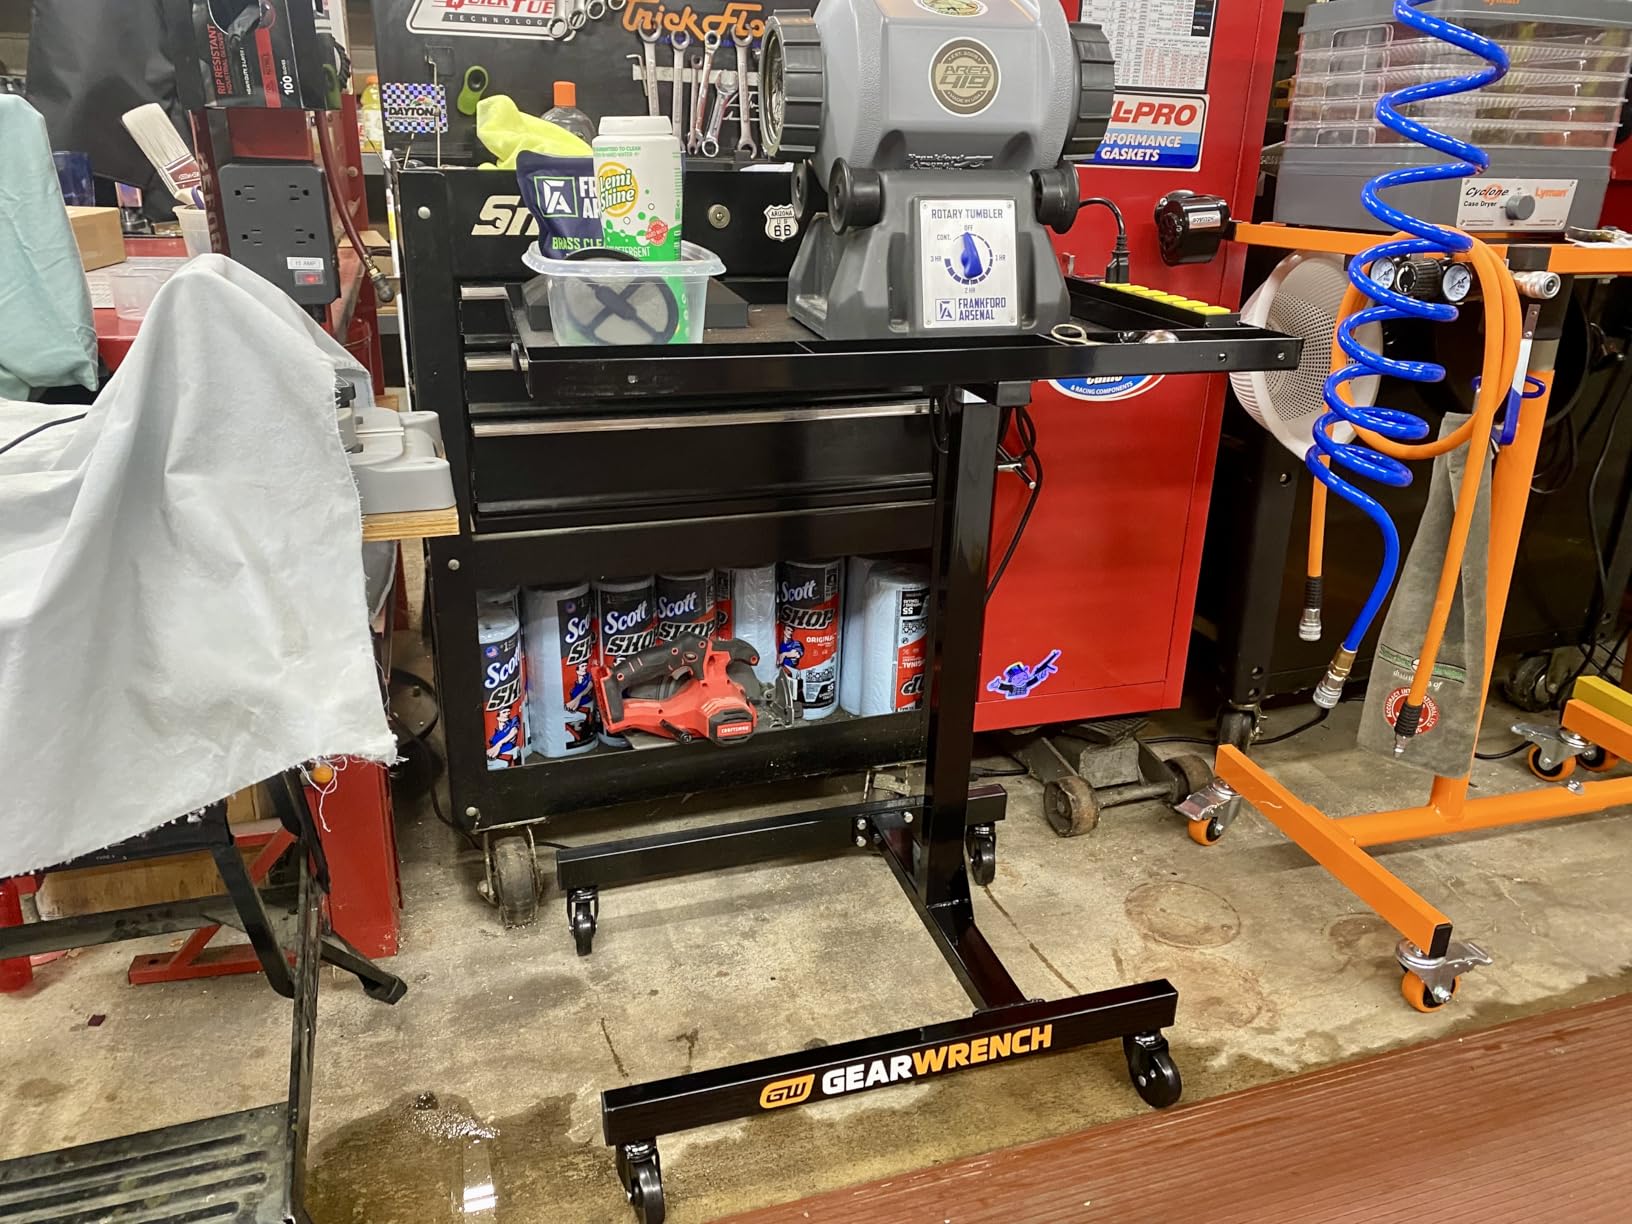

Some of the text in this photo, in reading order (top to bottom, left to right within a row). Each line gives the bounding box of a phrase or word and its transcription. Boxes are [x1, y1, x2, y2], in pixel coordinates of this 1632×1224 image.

[448, 14, 543, 26] TECHNOLOG
[622, 0, 766, 42] Trick Flo
[206, 23, 227, 96] RIP RESISTANT
[944, 65, 991, 76] AREA
[281, 75, 295, 96] 100
[939, 75, 991, 89] 419
[388, 106, 434, 116] DAYTON
[1110, 100, 1198, 126] L-PRO
[1101, 132, 1182, 148] RFORMANCE
[1100, 147, 1160, 162] GASKETS
[599, 168, 633, 193] Lemi
[600, 188, 636, 212] Shine
[1465, 187, 1569, 199] Cyclone Lyman
[1480, 201, 1498, 209] Dryer
[931, 208, 1004, 219] ROTARY TUMBLER
[774, 225, 792, 237] 66
[552, 236, 580, 250] BRASS
[583, 237, 603, 249] CLE
[958, 297, 1007, 309] FRANKFORD
[959, 309, 996, 321] ARSENAL
[1075, 386, 1096, 395] RACING
[1096, 381, 1134, 395] COMPONENTS
[781, 580, 816, 602] Scott
[658, 591, 698, 619] Scott
[604, 600, 648, 635] Scott
[781, 604, 836, 630] SHOP
[565, 614, 590, 644] Sco
[1386, 691, 1401, 718] ACCURACY
[821, 1023, 1053, 1096] GEARWRENCH
